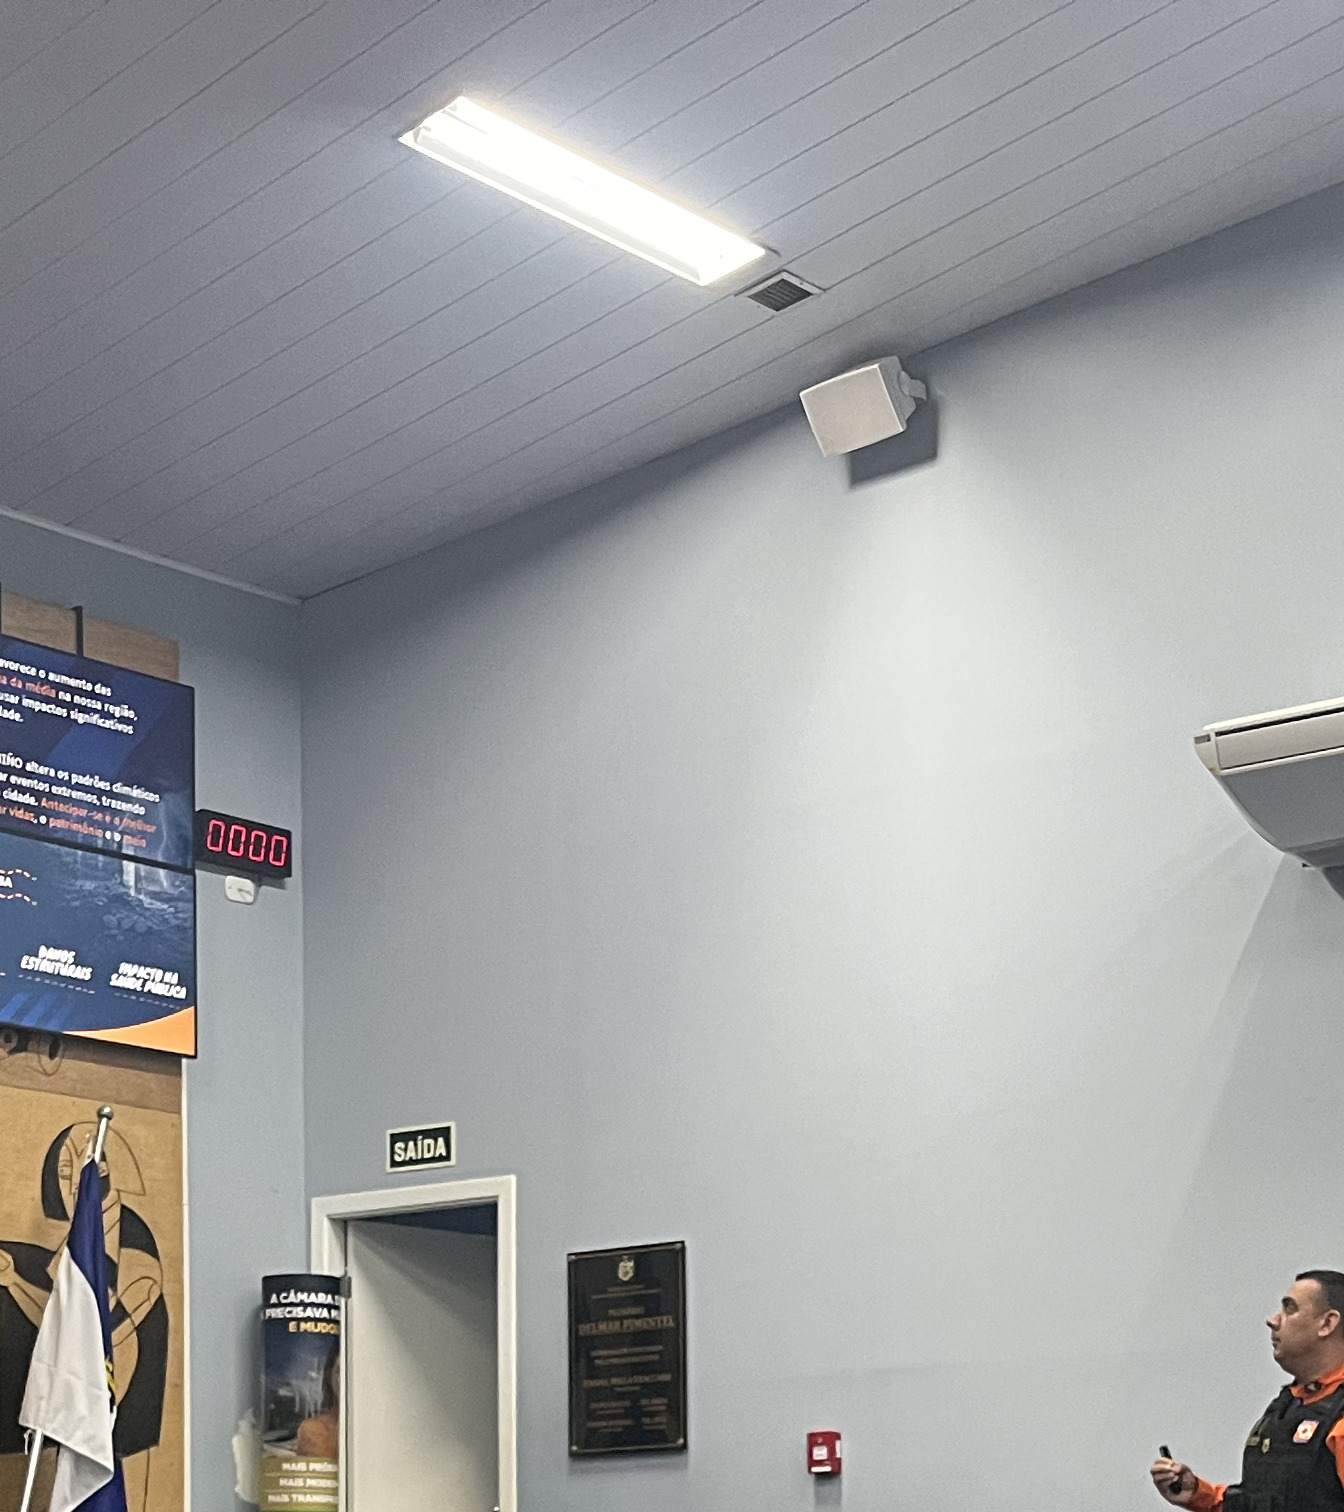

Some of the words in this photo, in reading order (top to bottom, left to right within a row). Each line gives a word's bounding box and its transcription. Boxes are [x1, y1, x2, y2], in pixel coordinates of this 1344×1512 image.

[9, 677, 23, 689] da
[58, 690, 72, 702] na
[73, 694, 102, 711] nossa
[38, 669, 46, 679] o
[48, 671, 93, 692] aumento
[94, 682, 112, 697] das
[21, 694, 68, 718] impactos
[25, 761, 55, 777] altera
[56, 769, 69, 780] os
[9, 774, 50, 793] eventos
[101, 795, 146, 815] trazendo
[207, 819, 287, 867] 0000
[38, 945, 76, 965] DANOS
[20, 955, 93, 981] ESTRUTURAIS
[118, 962, 163, 983] IMPACTO
[163, 971, 179, 984] NA
[393, 1135, 447, 1162] SAÍDA
[269, 1293, 278, 1304] A
[279, 1288, 334, 1305] CÂMARA
[265, 1306, 330, 1319] PRECISAVA
[288, 1321, 297, 1332] E
